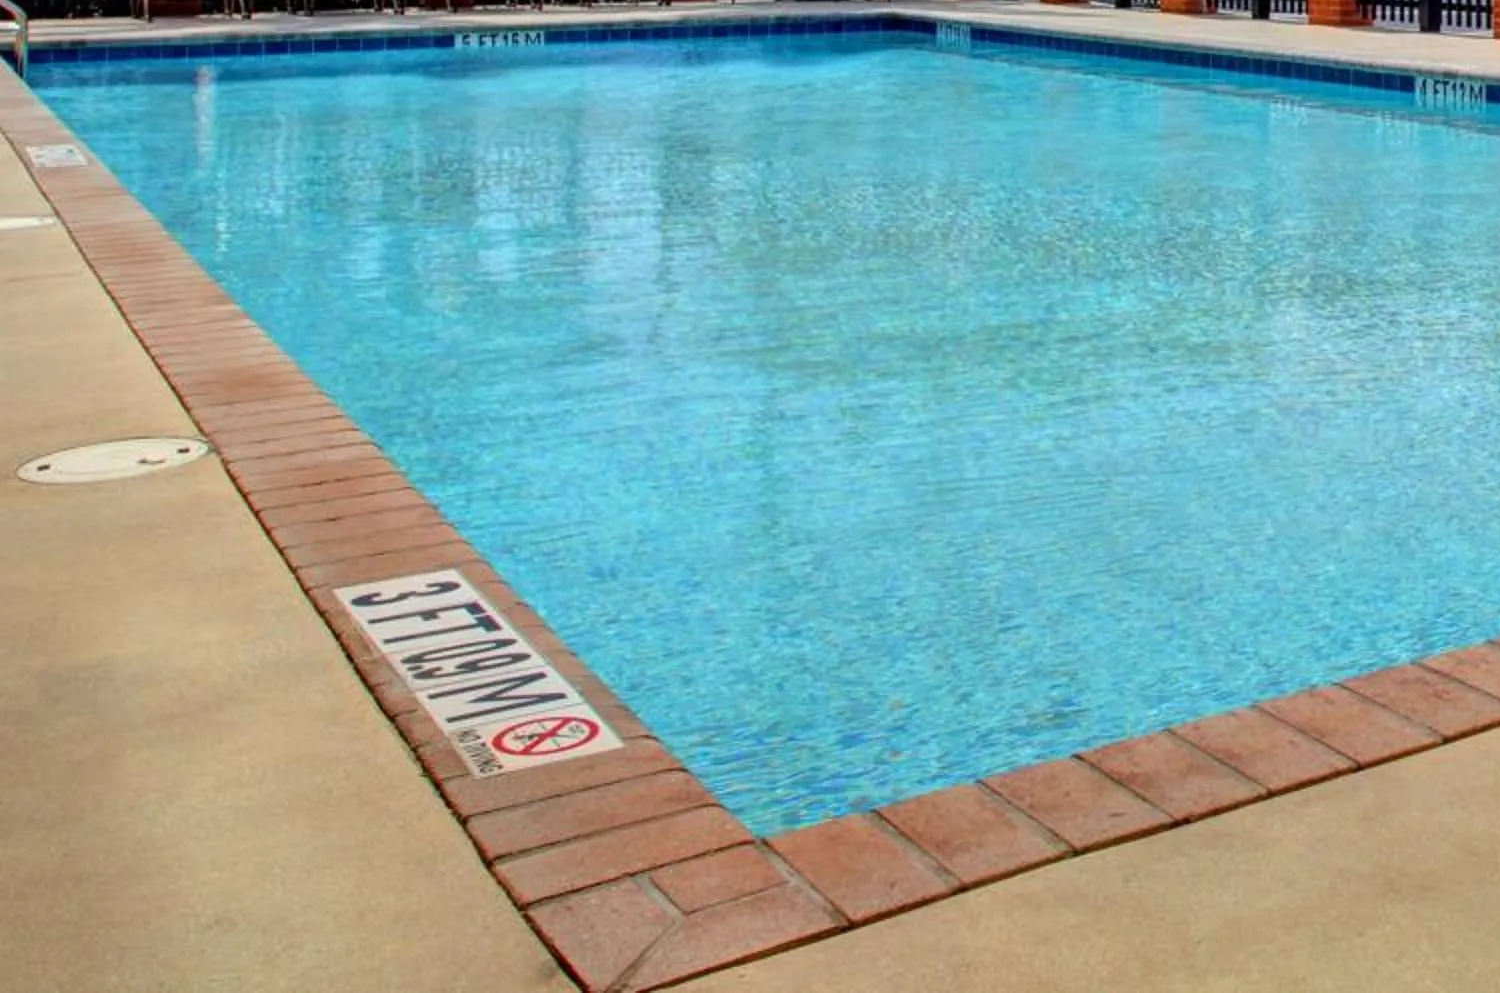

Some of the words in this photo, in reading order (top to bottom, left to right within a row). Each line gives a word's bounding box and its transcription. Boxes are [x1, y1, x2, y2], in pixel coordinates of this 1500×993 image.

[351, 579, 462, 607] 3
[367, 600, 503, 645] FT
[427, 671, 567, 724] M
